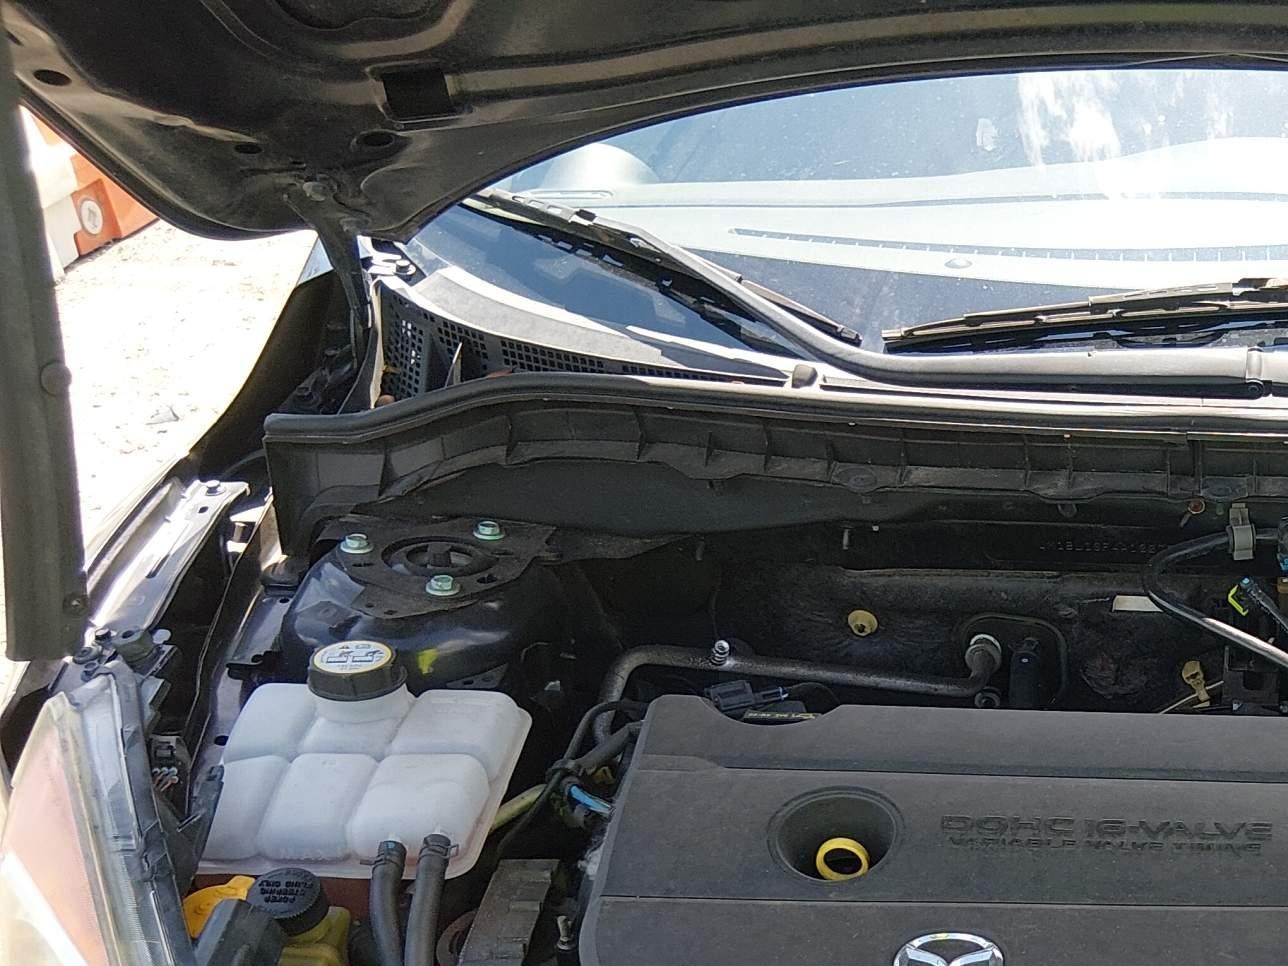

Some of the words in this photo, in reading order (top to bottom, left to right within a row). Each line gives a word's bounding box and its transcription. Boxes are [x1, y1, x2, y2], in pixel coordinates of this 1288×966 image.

[941, 815, 1074, 837] DOHC
[1086, 818, 1273, 841] 16-VALVE
[285, 880, 313, 888] FLUID
[260, 887, 305, 896] STEERING
[264, 895, 296, 903] POWER
